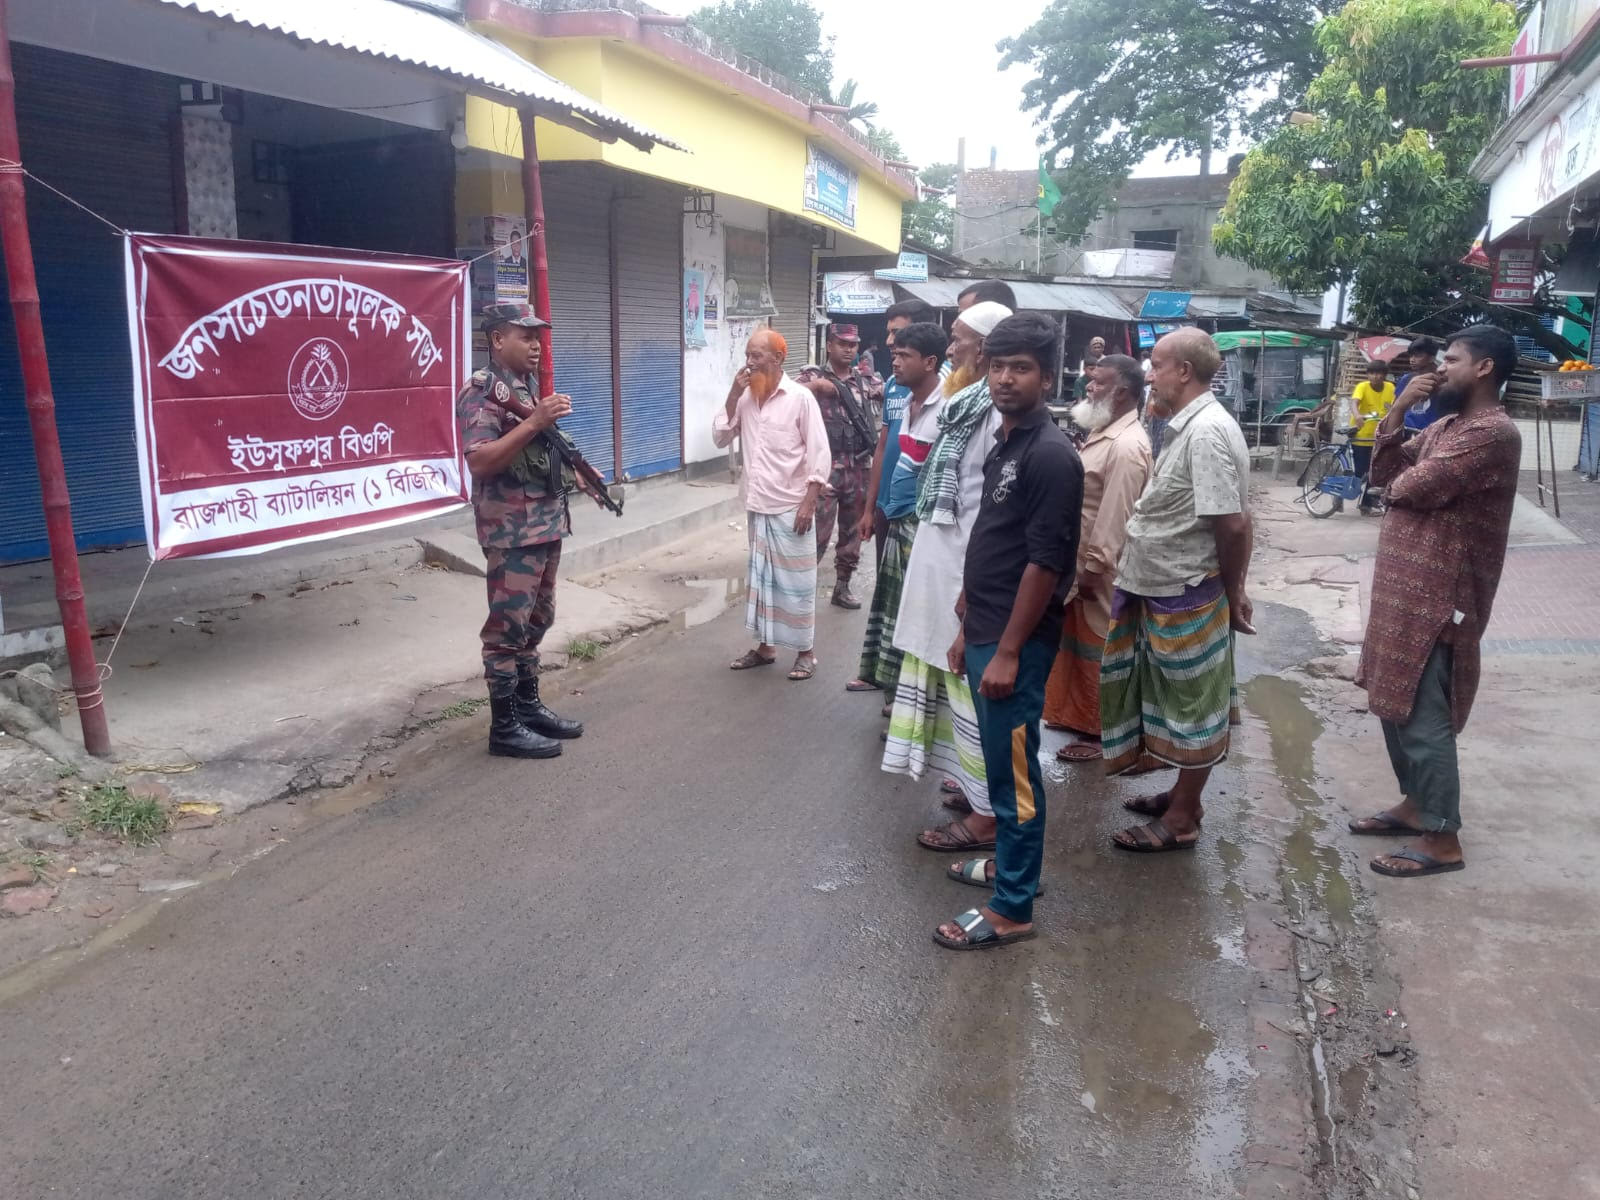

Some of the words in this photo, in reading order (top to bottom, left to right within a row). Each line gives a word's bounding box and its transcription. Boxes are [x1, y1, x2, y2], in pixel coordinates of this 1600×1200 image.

[158, 275, 406, 380] জনসচেতনতামূলক
[406, 314, 443, 378] সভা
[227, 434, 335, 473] ইউসুফপুর
[338, 422, 394, 459] বিওপি
[171, 488, 258, 531] রাজশাহী
[264, 479, 356, 516] ব্যাটালিয়ন
